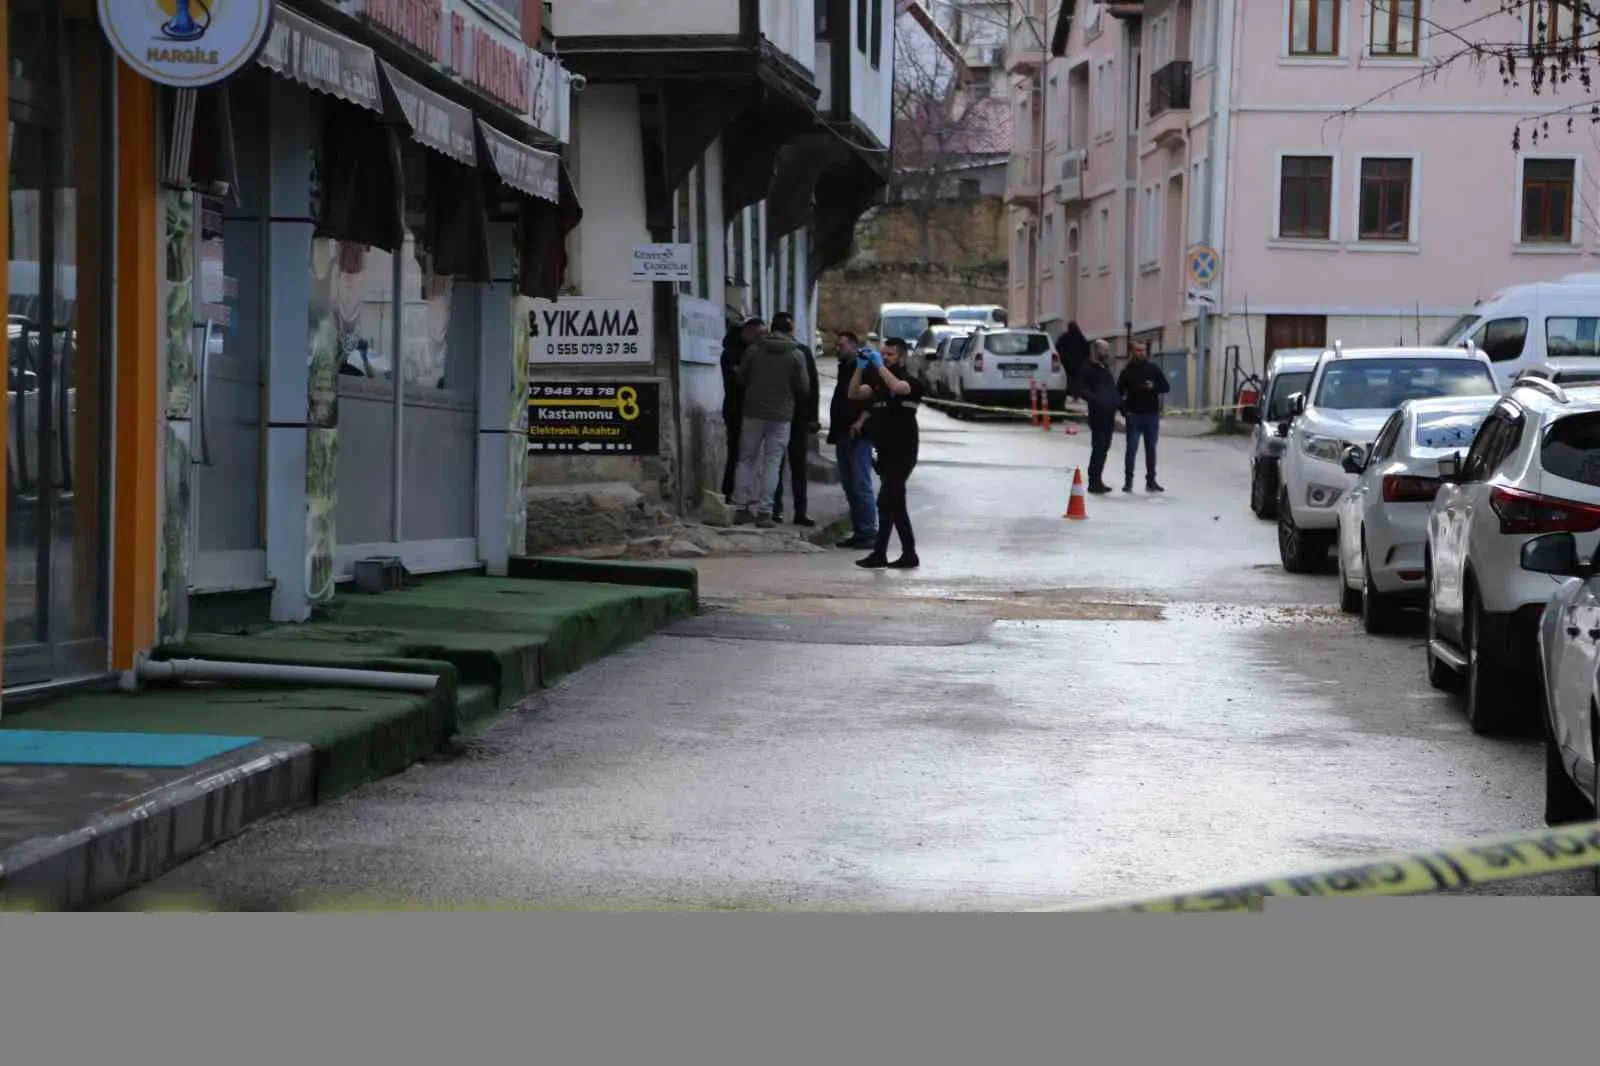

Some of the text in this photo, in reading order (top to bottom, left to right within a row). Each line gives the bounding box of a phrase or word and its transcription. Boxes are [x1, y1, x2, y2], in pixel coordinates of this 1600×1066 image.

[542, 309, 639, 337] YIKAMA
[546, 342, 638, 355] 0 555 079 37 36
[543, 386, 573, 396] 948
[575, 386, 594, 396] 78
[597, 386, 616, 396] 78
[538, 407, 614, 420] Kastamonu
[530, 425, 621, 435] Elektronik Anahtar
